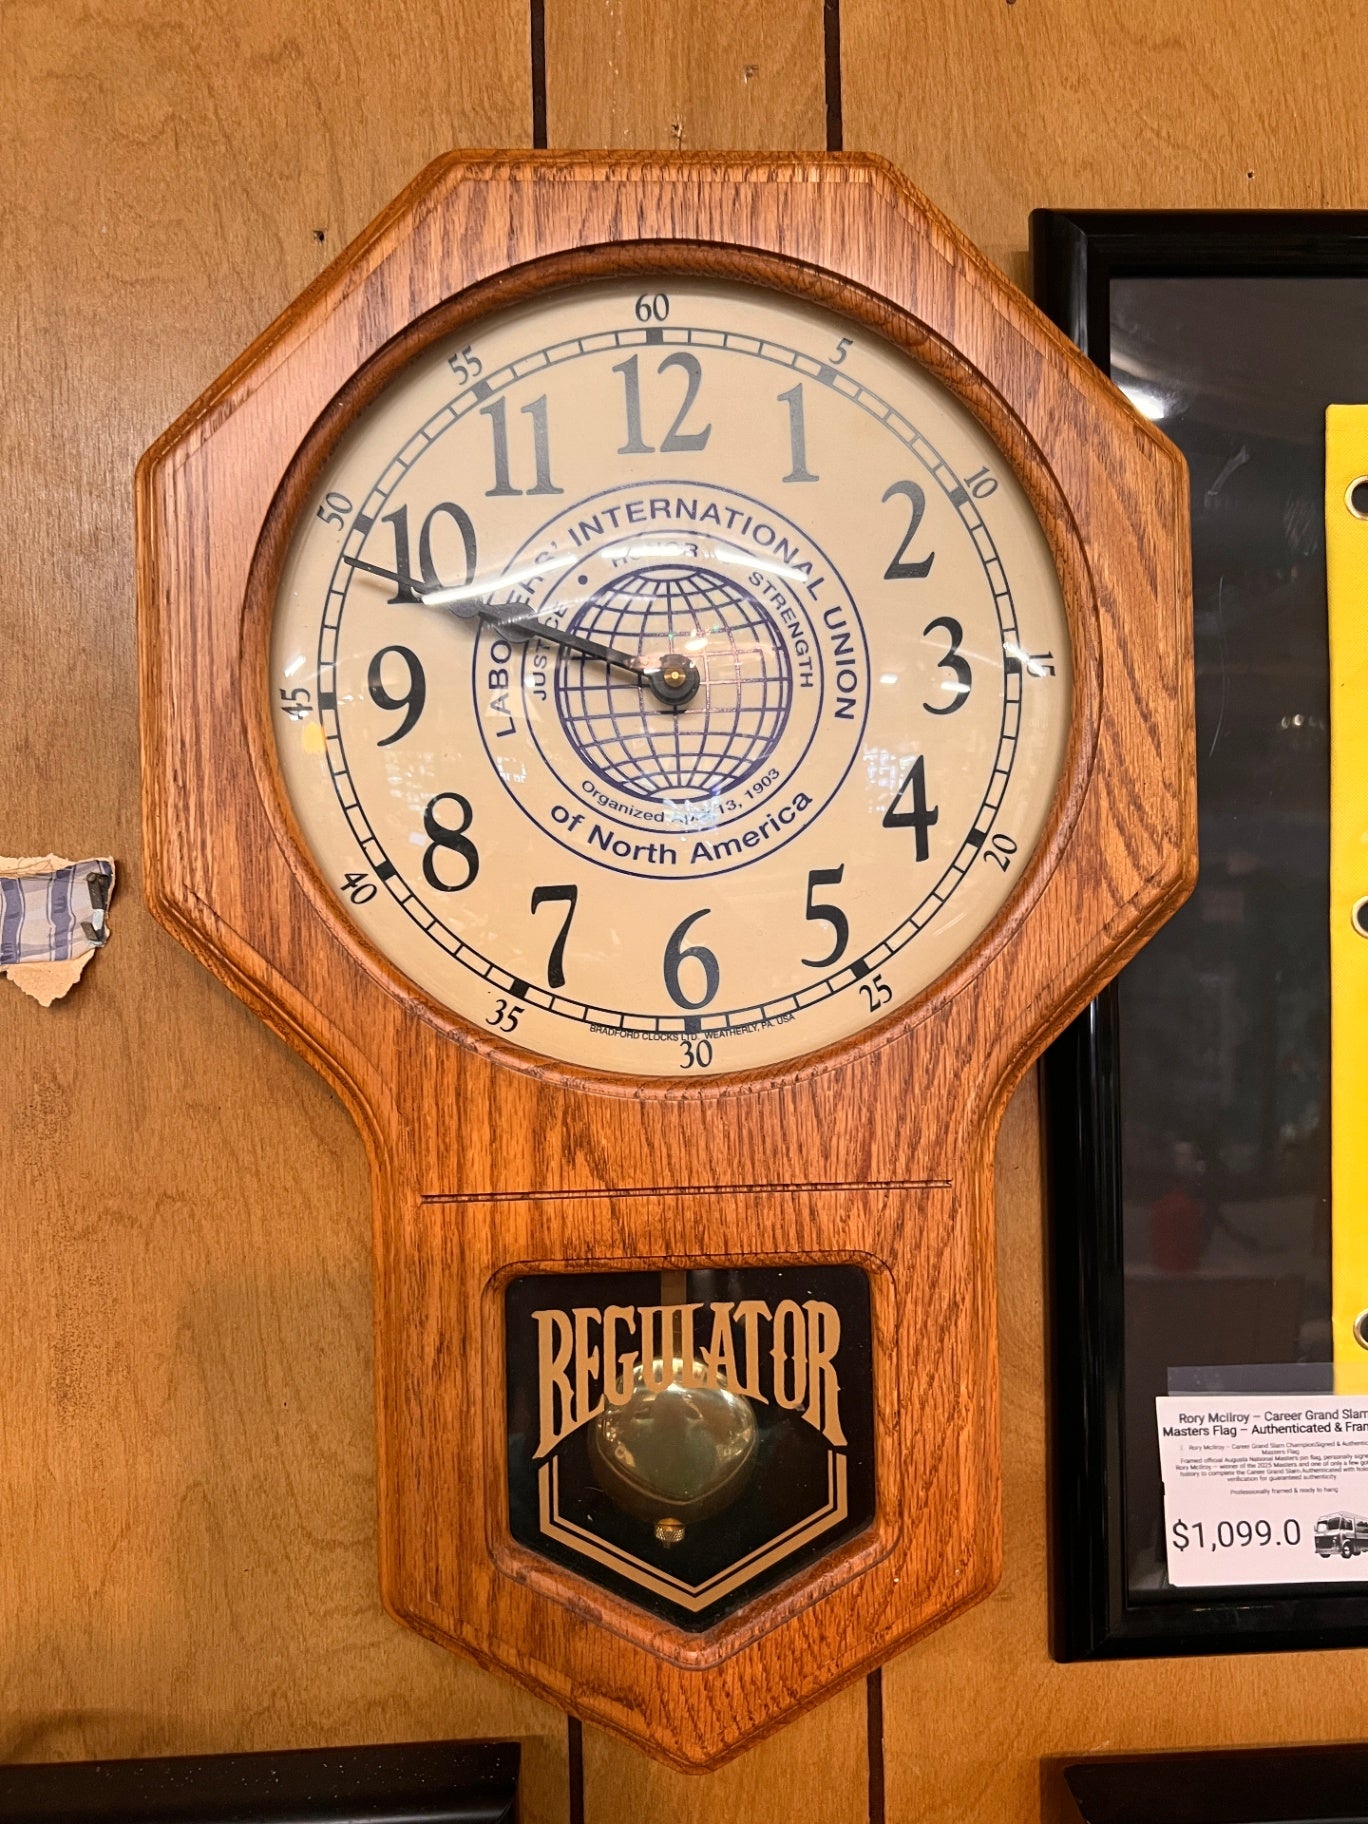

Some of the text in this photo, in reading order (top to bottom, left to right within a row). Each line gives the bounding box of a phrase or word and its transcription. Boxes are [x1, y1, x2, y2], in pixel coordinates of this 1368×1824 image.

[635, 293, 670, 322] 60
[447, 345, 483, 386] 55
[829, 337, 853, 365] 5
[612, 352, 712, 454] 12
[480, 394, 564, 497] 11
[777, 382, 820, 483] 1
[963, 466, 999, 500] 10
[316, 492, 354, 532] 50
[881, 480, 935, 580] 2
[381, 502, 477, 604] 10
[568, 498, 825, 600] INTERNATIONAL
[824, 606, 857, 720] UNION
[748, 571, 814, 688] STRENGTH
[923, 616, 972, 715] 3
[280, 688, 314, 720] 45
[368, 645, 426, 747] 9
[582, 780, 665, 823] Organized
[718, 767, 780, 815] 13, 1903
[882, 755, 939, 862] 4
[422, 792, 480, 892] 8
[550, 804, 586, 833] of
[587, 824, 677, 865] North
[690, 791, 813, 865] America
[983, 833, 1018, 872] 20
[340, 872, 378, 905] 40
[531, 884, 578, 988] 7
[801, 863, 849, 968] 5
[663, 908, 720, 1010] 6
[485, 999, 525, 1032] 35
[859, 974, 893, 1012] 25
[590, 1024, 640, 1039] BRADFORD
[641, 1032, 679, 1041] CLOCKS
[776, 1013, 796, 1025] USA
[679, 1039, 714, 1069] 30
[531, 1299, 848, 1460] REGULATOR
[1162, 1427, 1210, 1437] Masters
[1213, 1425, 1237, 1438] Flag
[1251, 1422, 1331, 1434] Authenticated
[1334, 1422, 1342, 1432] &
[1178, 1413, 1204, 1425] Rory
[1208, 1411, 1250, 1424] McIlroy
[1264, 1411, 1302, 1421] Career
[1305, 1409, 1339, 1420] Grand
[1172, 1518, 1301, 1552] $1,099.0
